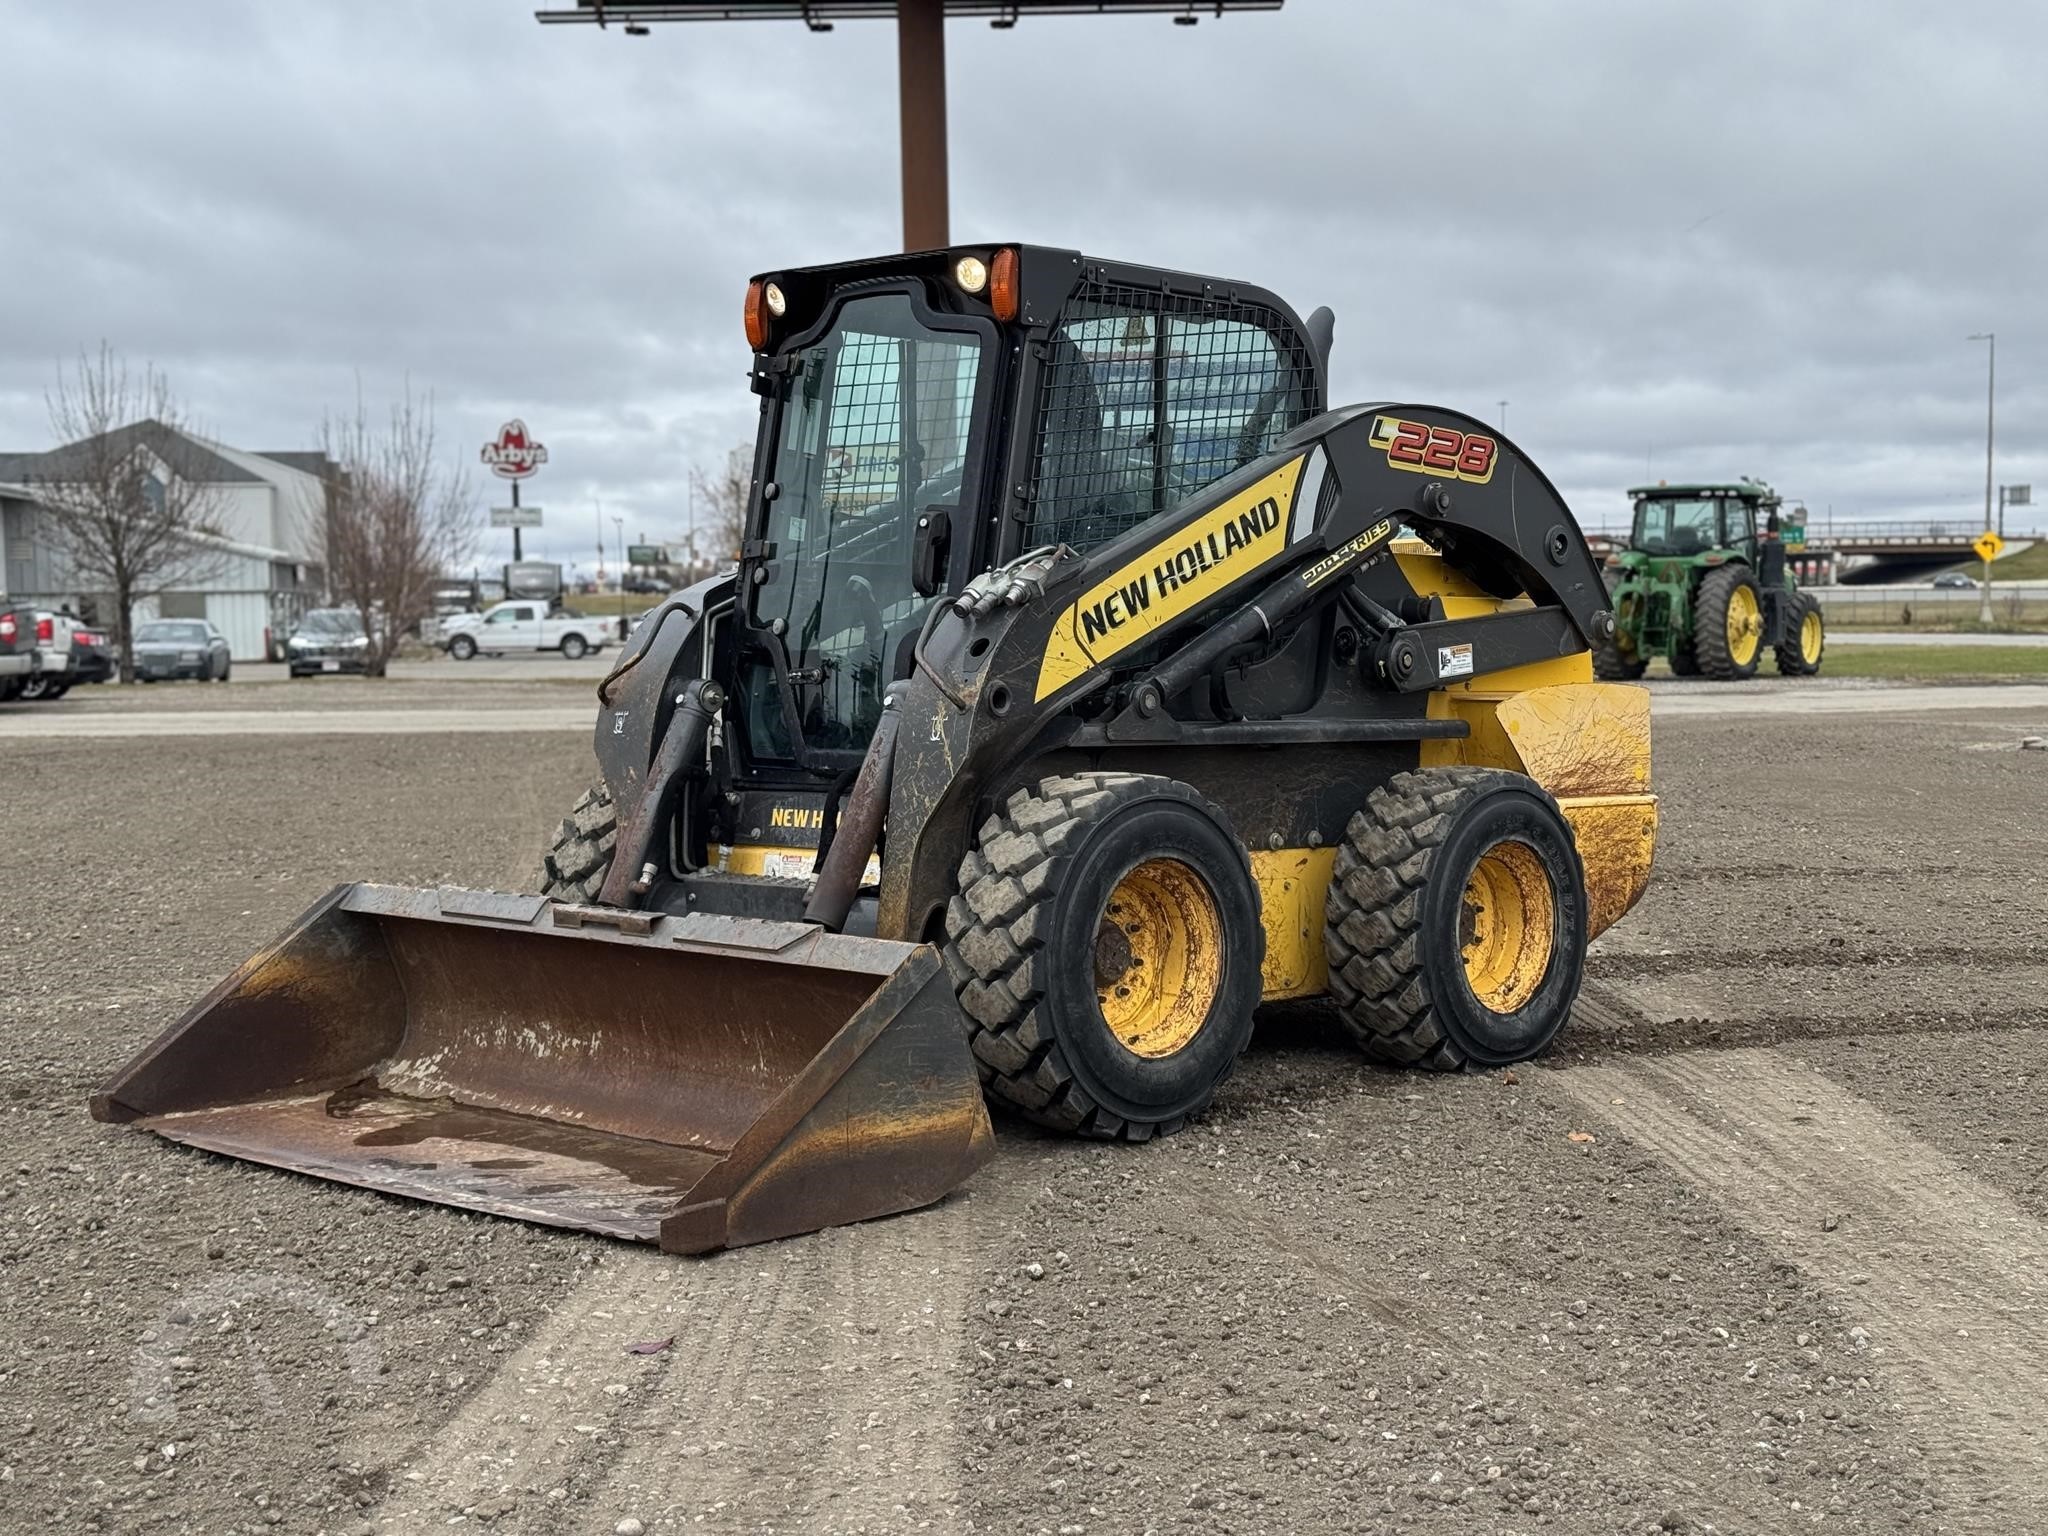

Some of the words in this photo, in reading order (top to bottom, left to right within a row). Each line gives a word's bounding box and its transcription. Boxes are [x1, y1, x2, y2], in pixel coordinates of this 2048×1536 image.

[1369, 416, 1498, 483] L228
[1081, 573, 1151, 645] NEW
[1152, 496, 1281, 600] HOLLAND
[770, 807, 810, 829] NEW
